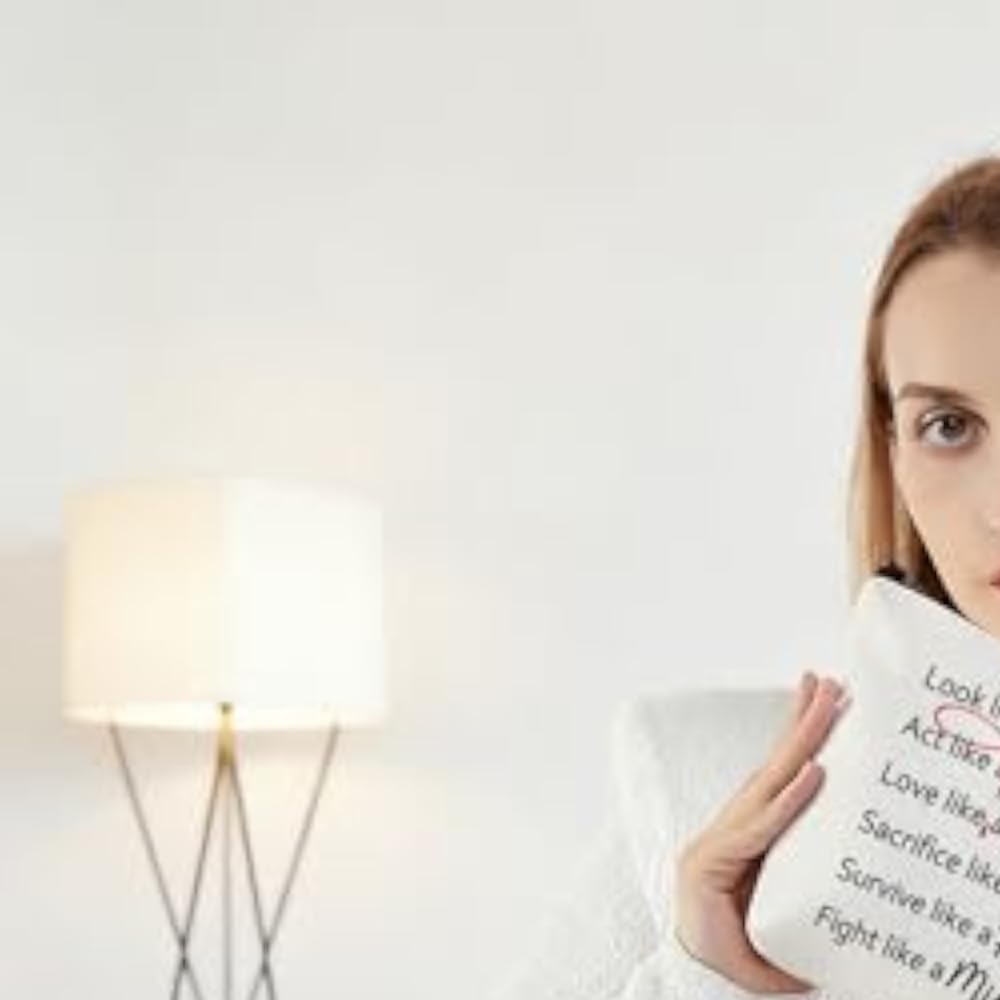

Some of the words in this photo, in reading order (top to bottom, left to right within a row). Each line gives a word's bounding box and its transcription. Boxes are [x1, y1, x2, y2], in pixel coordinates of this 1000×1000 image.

[925, 664, 985, 705] Look
[900, 716, 943, 749] Act
[947, 733, 990, 770] like
[881, 762, 938, 799] Love
[945, 789, 986, 824] like
[858, 808, 962, 874] Sacrifice
[836, 857, 926, 914] Survive
[930, 899, 973, 938] like
[977, 927, 991, 946] a
[814, 904, 880, 950] Fight
[882, 933, 926, 970] like
[930, 961, 945, 980] a
